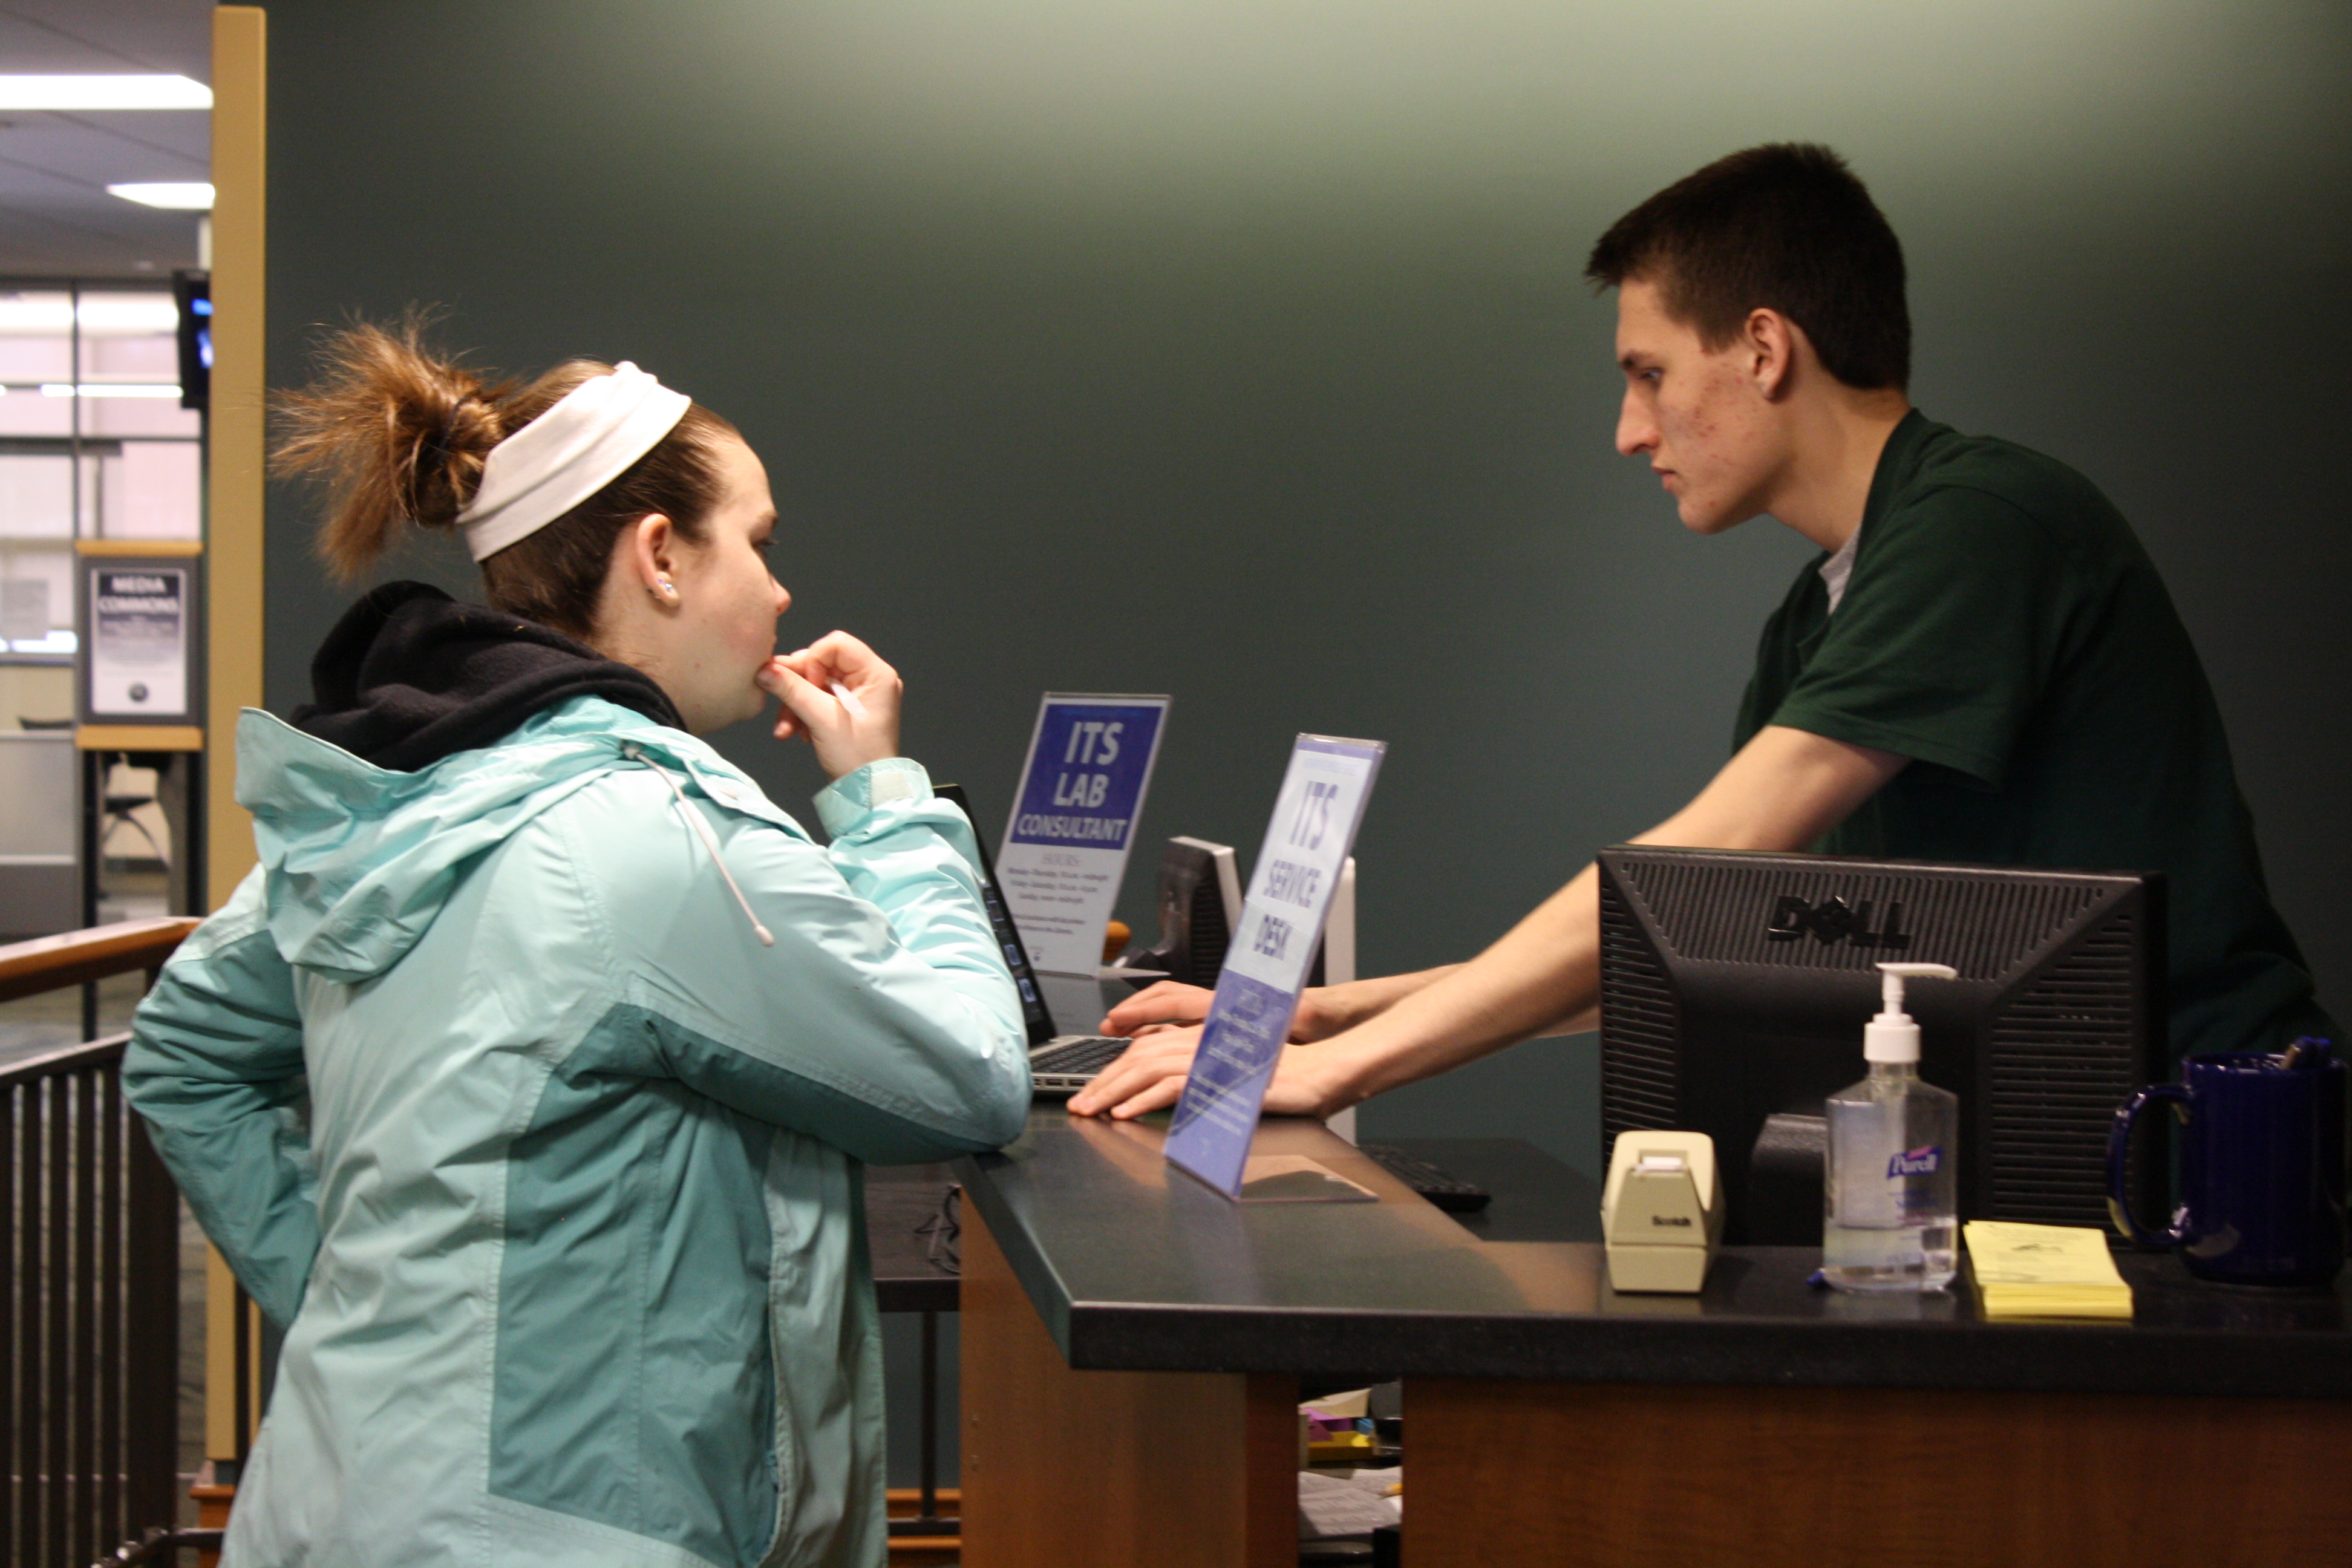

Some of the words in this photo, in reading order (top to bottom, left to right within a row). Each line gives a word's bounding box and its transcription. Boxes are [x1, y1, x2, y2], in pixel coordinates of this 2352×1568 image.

[111, 577, 166, 593] MEDIA
[1064, 721, 1124, 765] ITS
[1053, 773, 1109, 808] LAB
[1017, 814, 1127, 841] CONSULTANT
[1289, 780, 1338, 851] ITS
[1264, 860, 1321, 908] SERVICE
[1252, 913, 1293, 960] DESK
[1768, 896, 1910, 949] DELL
[1891, 1153, 1938, 1174] Purell
[1651, 1215, 1691, 1227] Scotch
